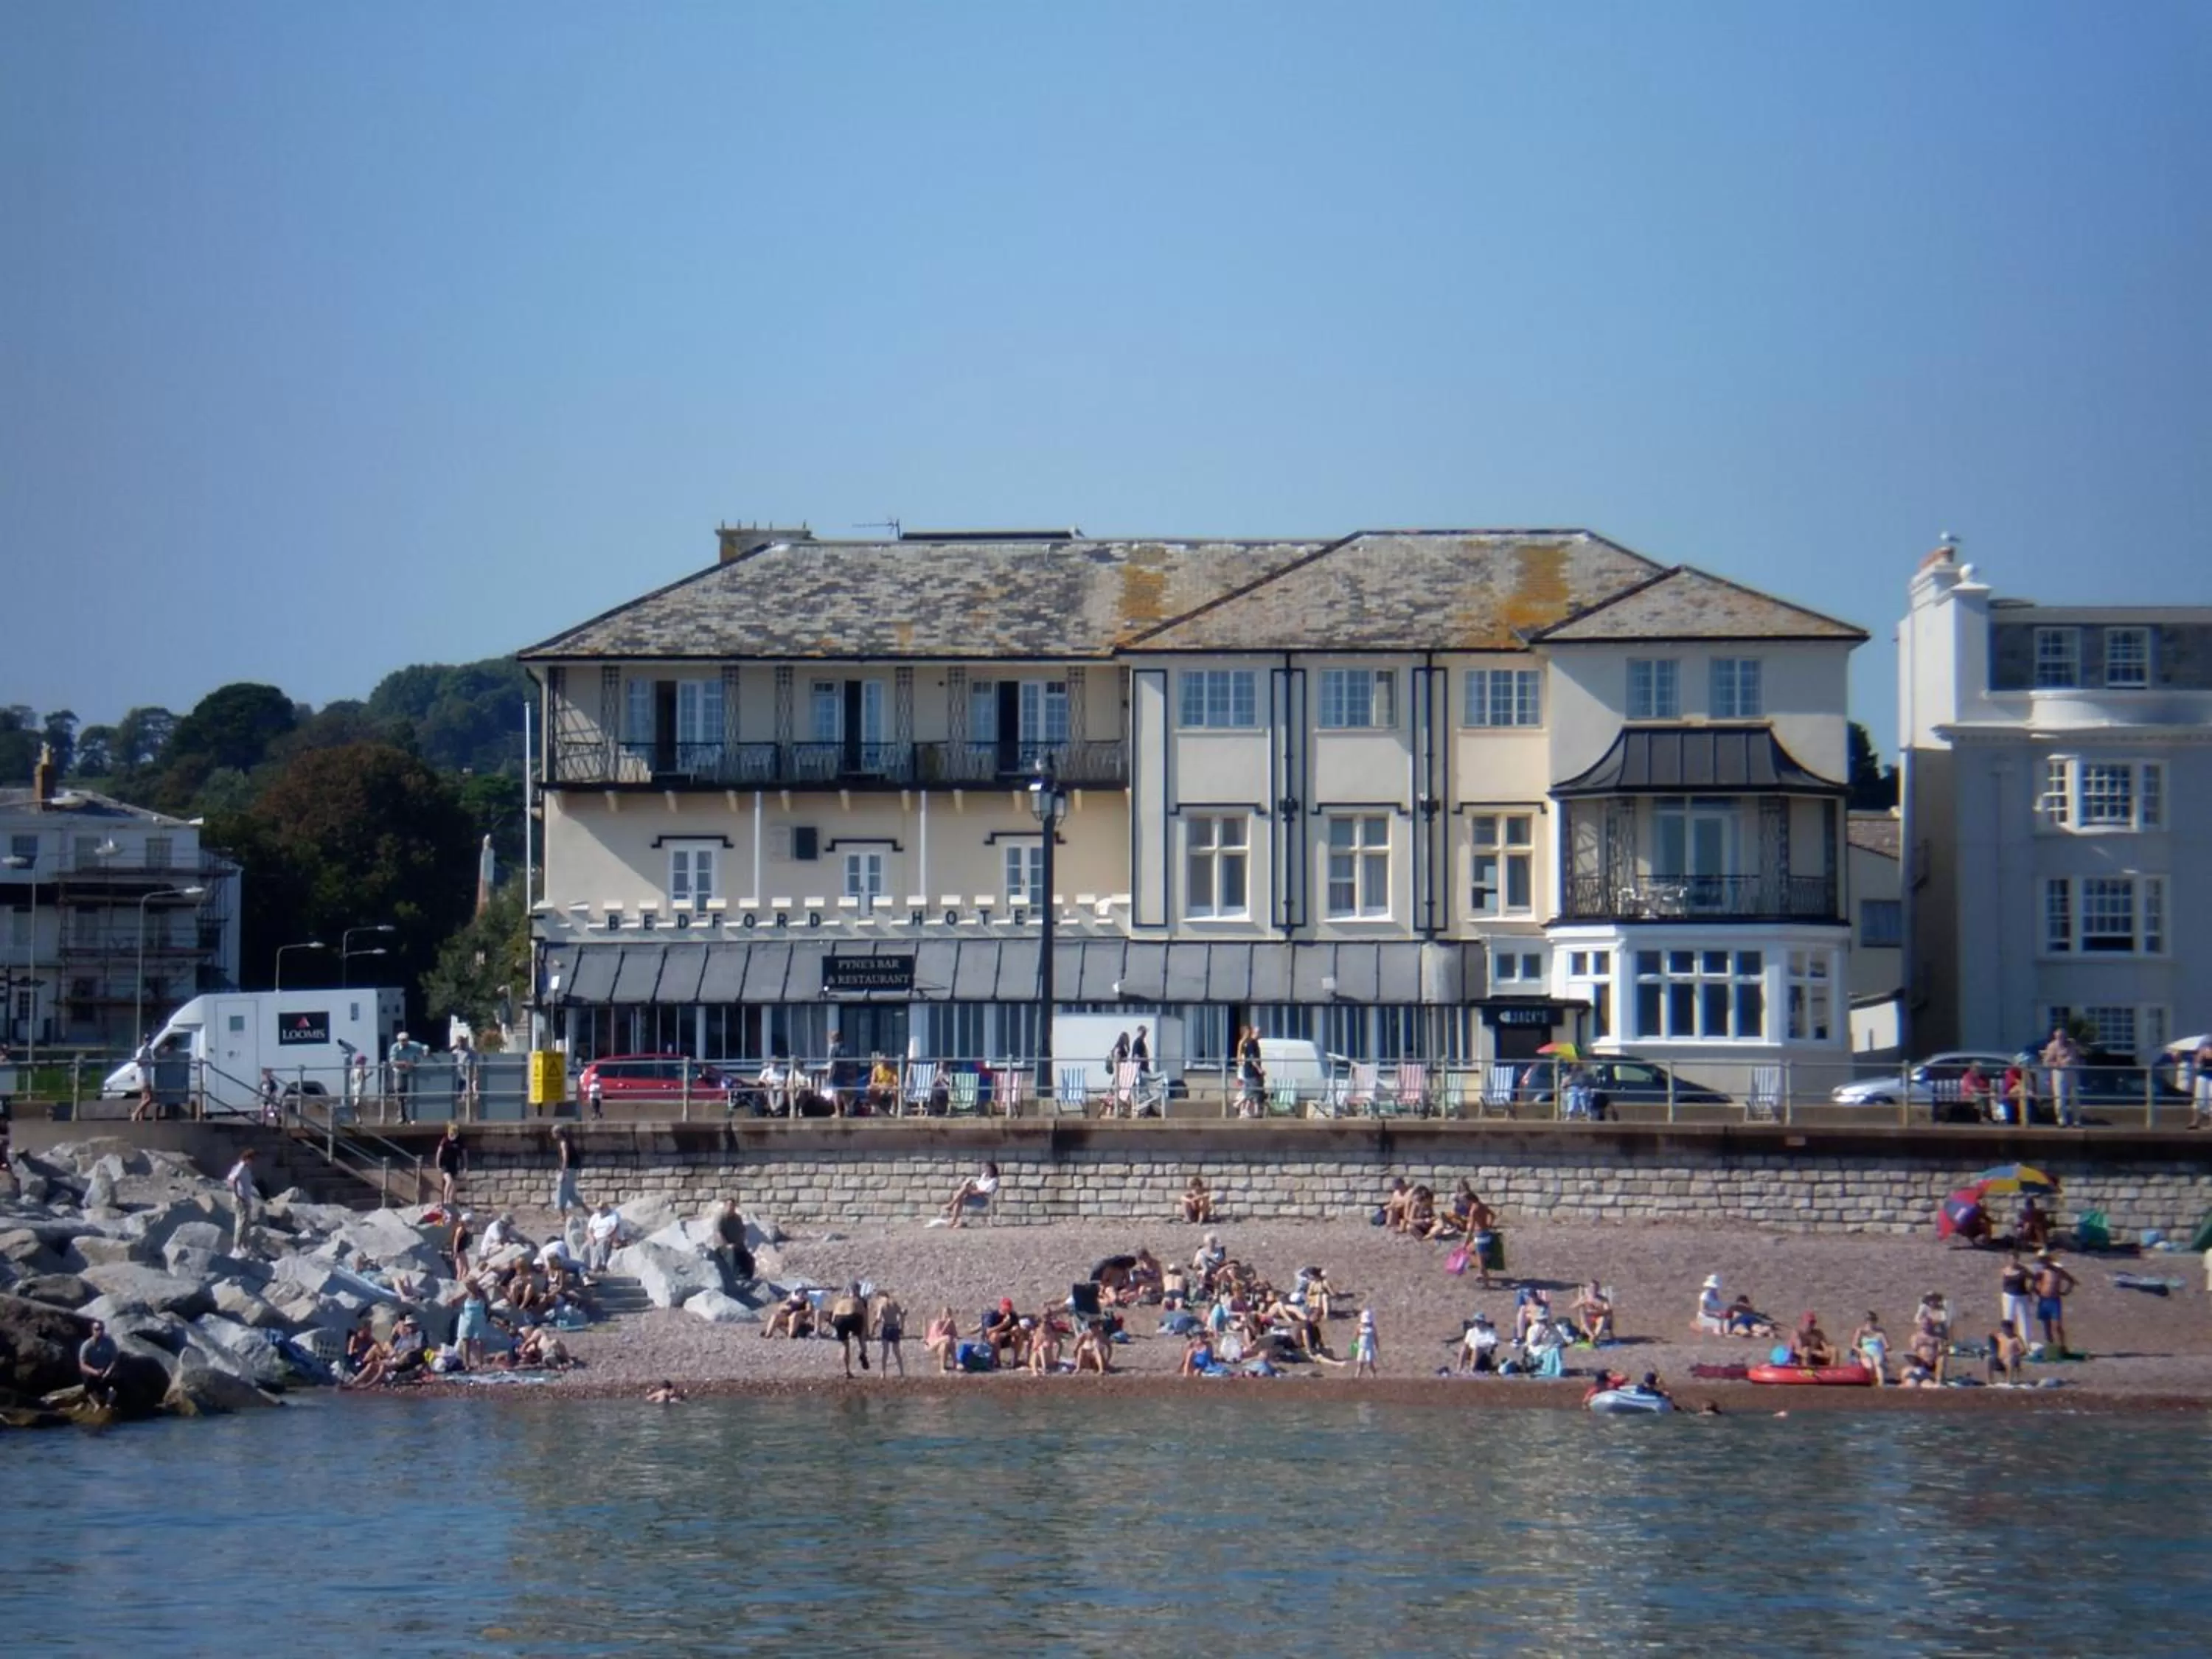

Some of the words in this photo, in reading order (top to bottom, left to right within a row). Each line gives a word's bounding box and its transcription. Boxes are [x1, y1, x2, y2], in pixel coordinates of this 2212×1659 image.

[608, 912, 821, 931] BEDFORD
[911, 909, 1058, 927] HOTE
[877, 959, 899, 970] BAR
[838, 974, 909, 984] RESTAURANT
[282, 1029, 325, 1040] LOOMIS
